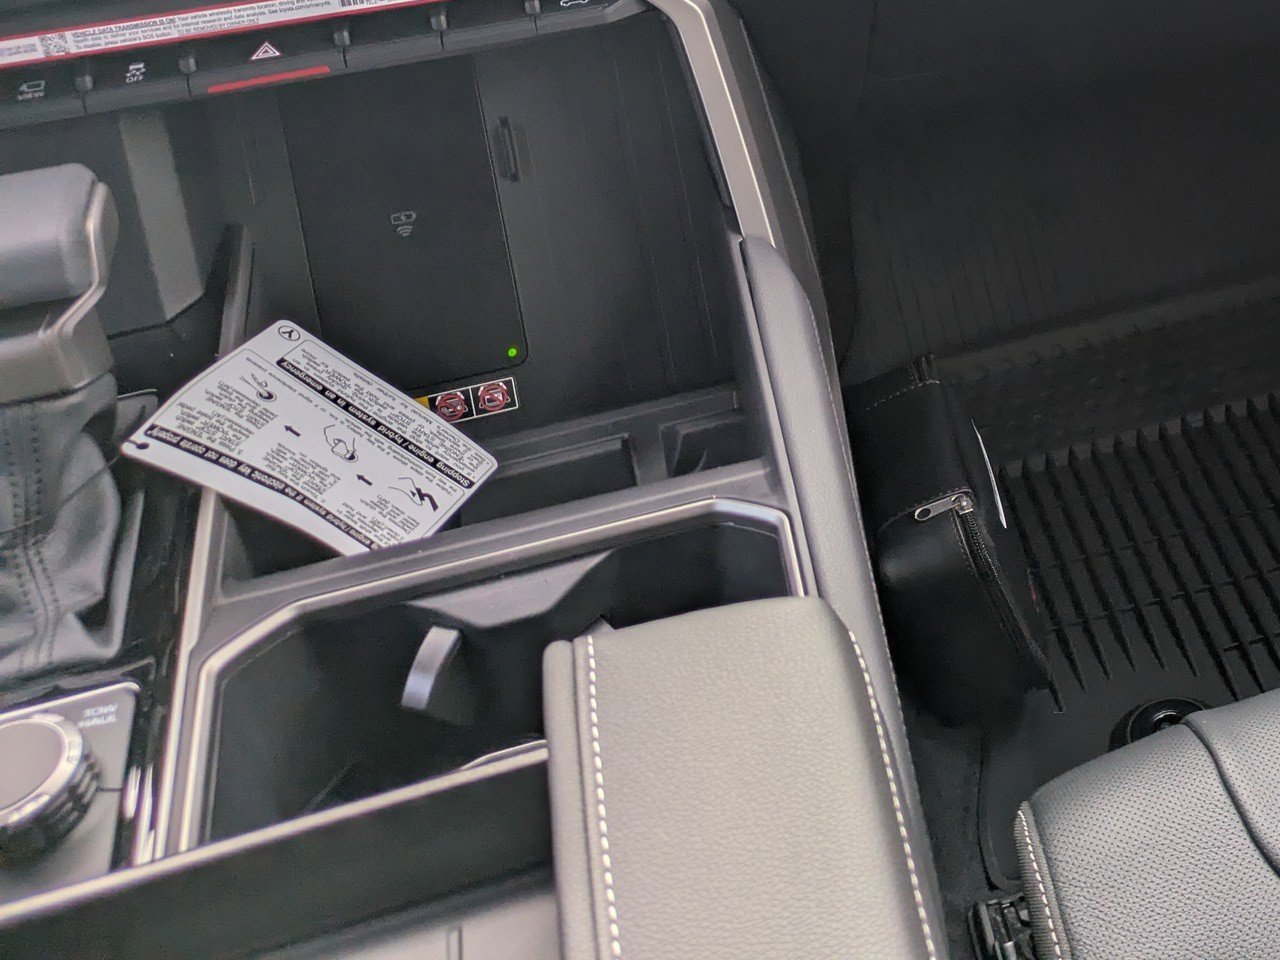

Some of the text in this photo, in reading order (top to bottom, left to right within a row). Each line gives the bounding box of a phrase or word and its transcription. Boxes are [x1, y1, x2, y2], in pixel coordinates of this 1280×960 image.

[279, 359, 324, 391] emergency
[324, 389, 336, 400] an
[336, 397, 346, 406] in
[348, 404, 377, 426] system
[377, 423, 404, 444] hybrid
[435, 460, 471, 486] Stopping
